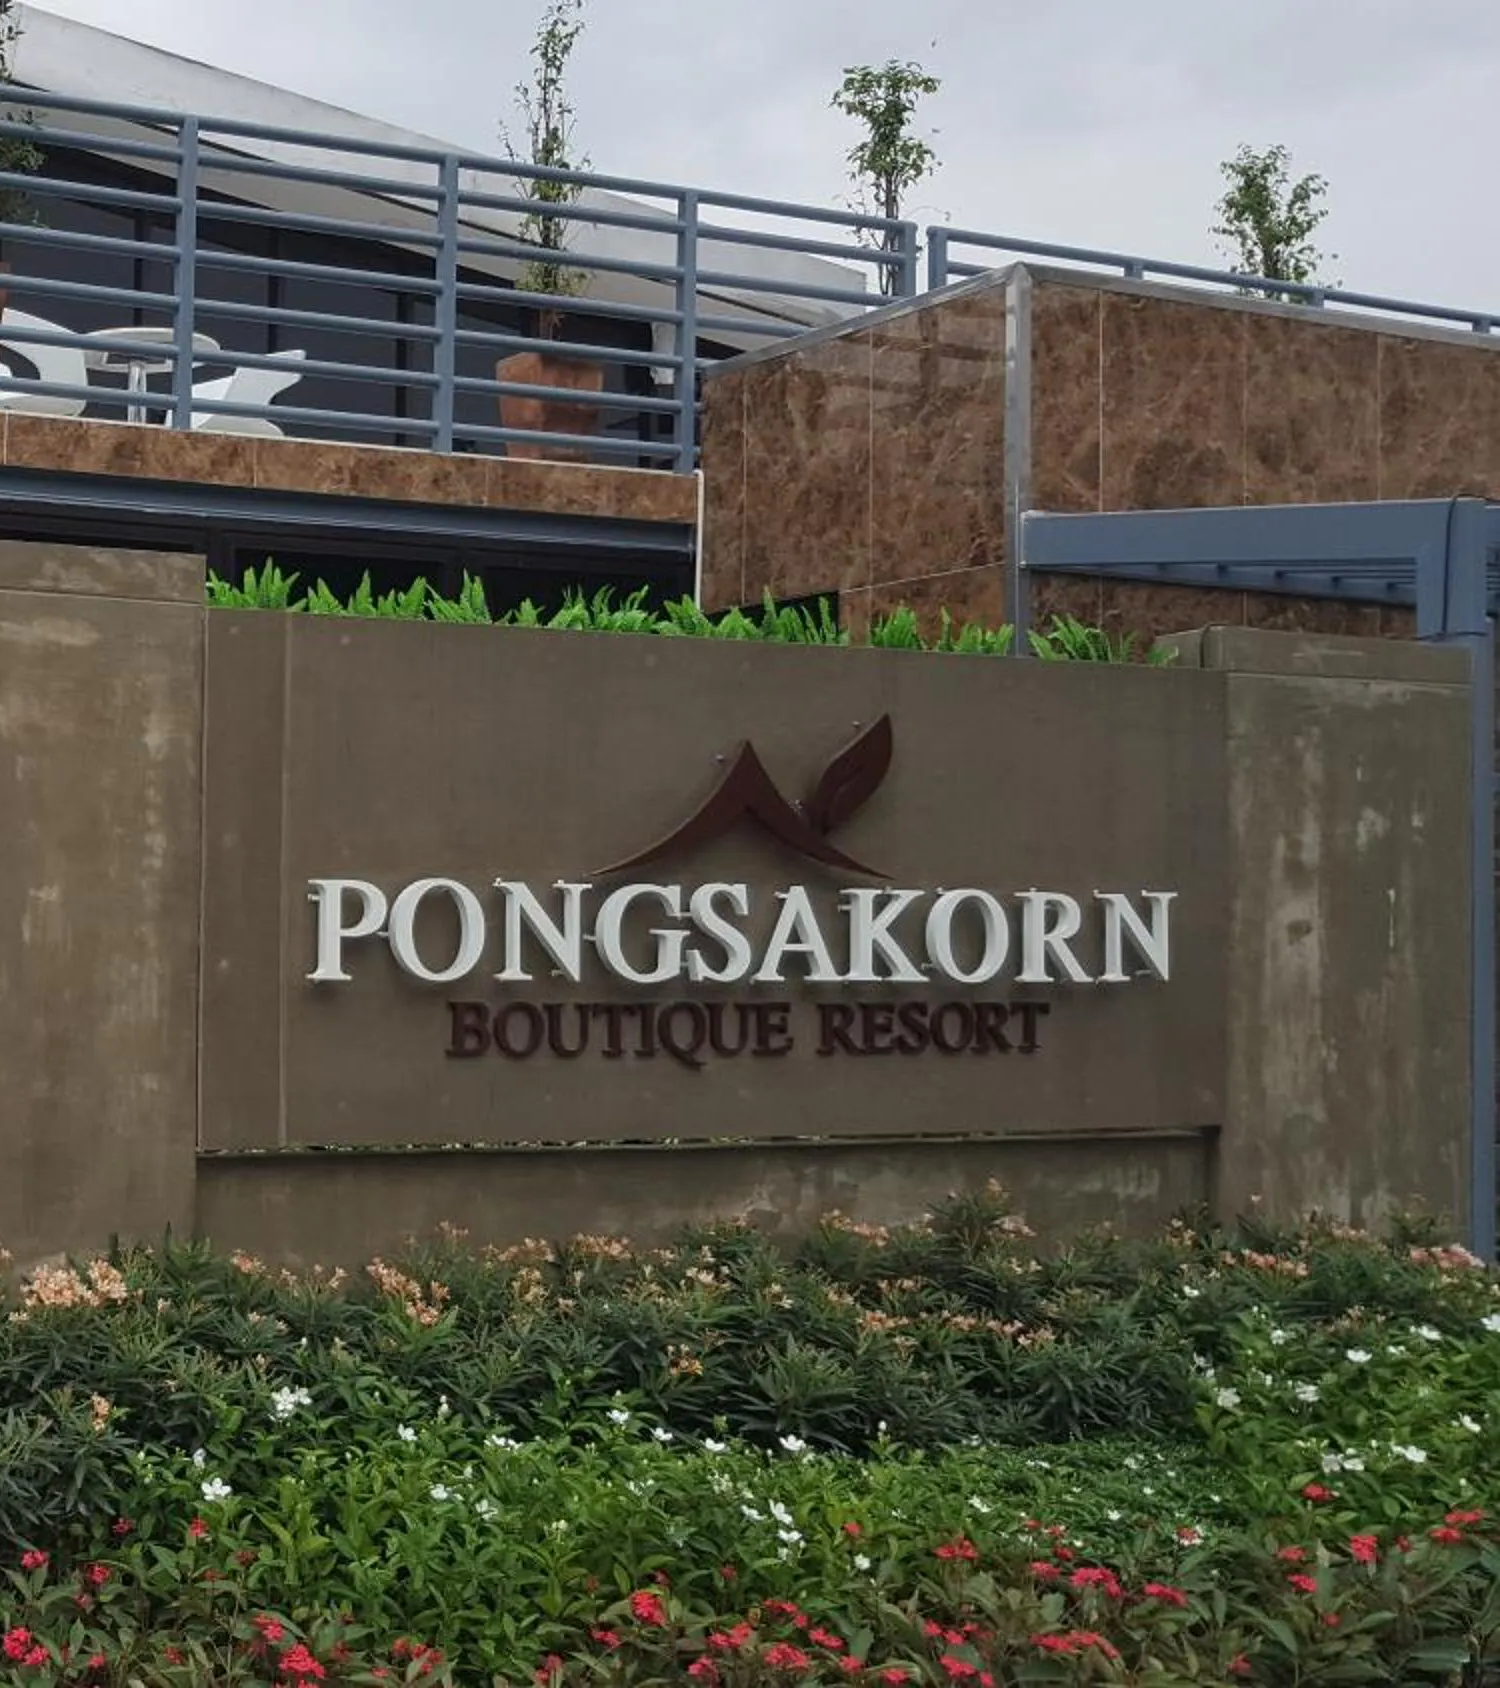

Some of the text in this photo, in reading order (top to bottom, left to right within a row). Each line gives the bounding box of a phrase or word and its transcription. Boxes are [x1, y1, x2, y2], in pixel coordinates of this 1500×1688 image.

[305, 877, 1178, 984] PONGSAKORN
[445, 1001, 1050, 1067] BOUTIQUE RESORT
